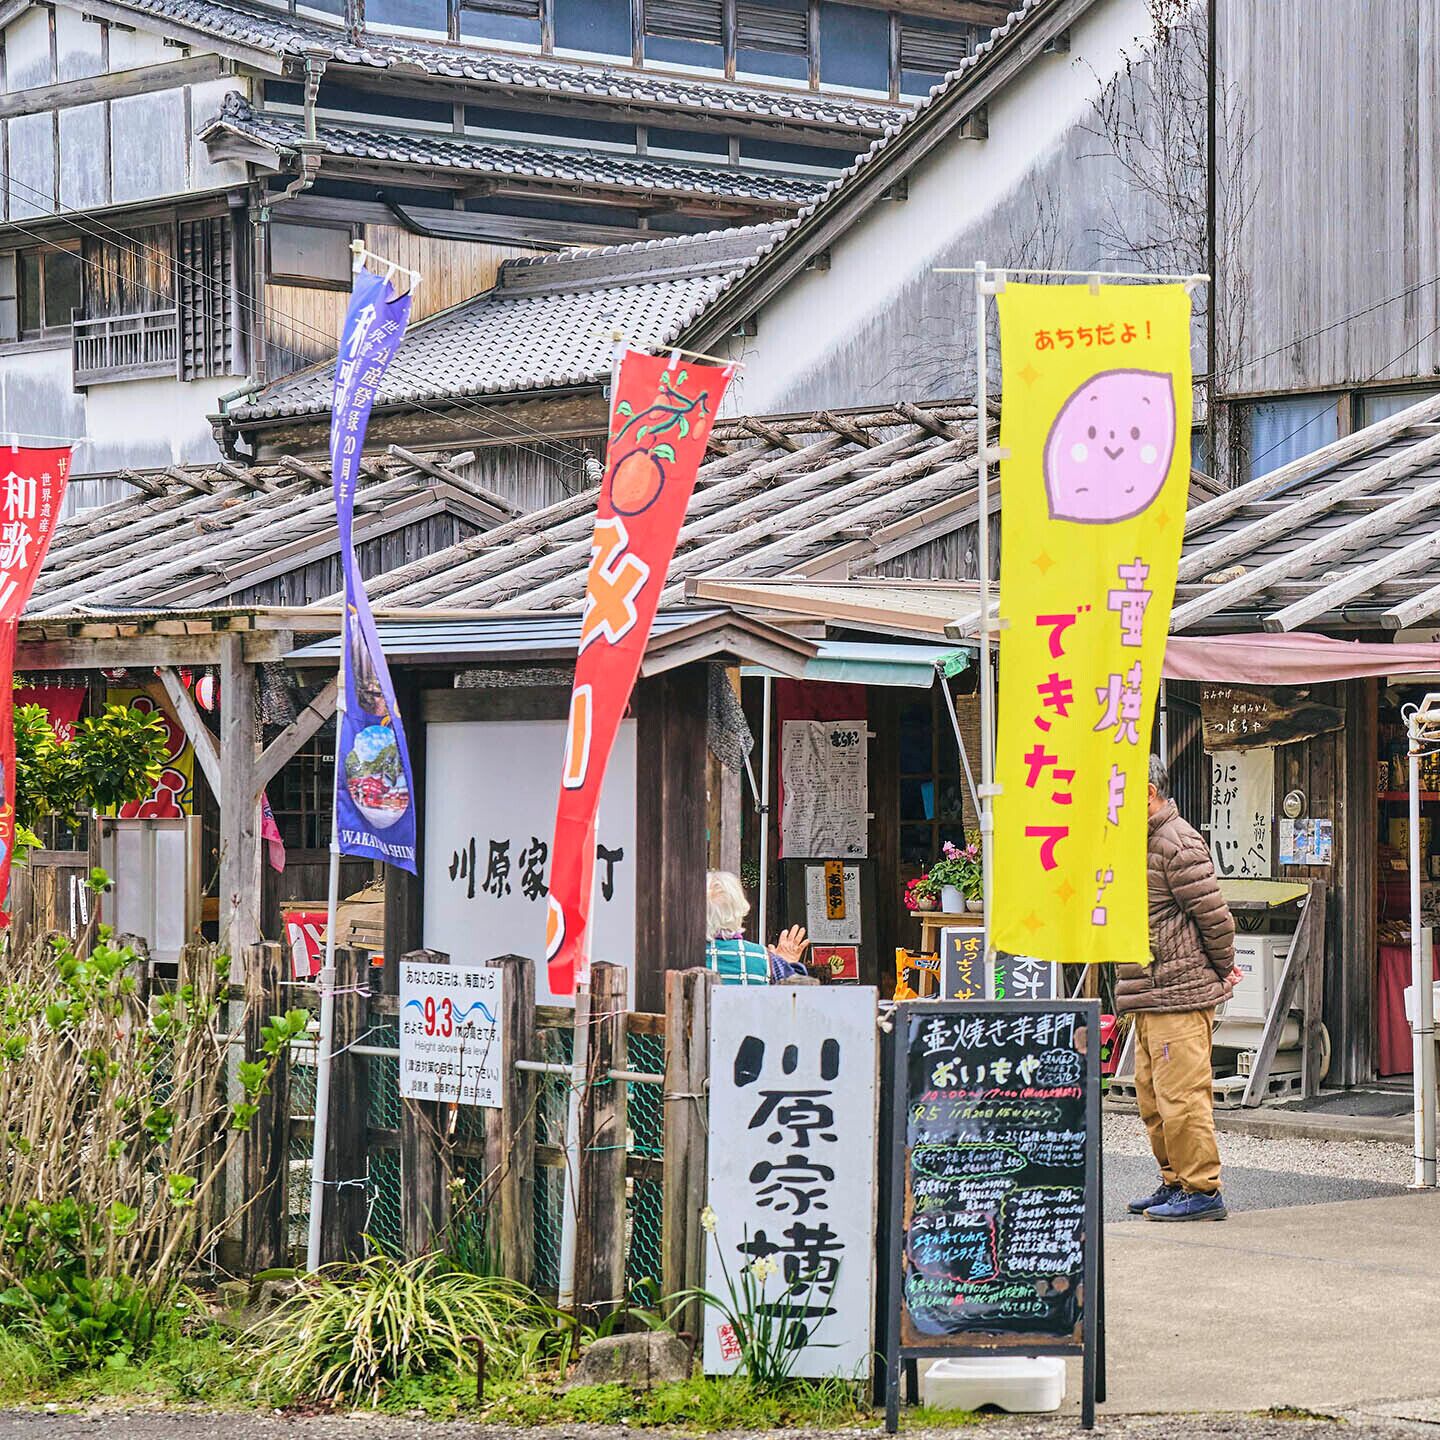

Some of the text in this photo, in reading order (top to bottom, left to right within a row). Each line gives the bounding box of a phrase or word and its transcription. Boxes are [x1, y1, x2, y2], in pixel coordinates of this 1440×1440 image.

[1033, 320, 1153, 353] あちちだよ！
[1023, 603, 1092, 873] できたて
[1212, 763, 1223, 829] うま！
[1223, 765, 1238, 830] にが！
[449, 837, 625, 903] 川原家丁
[406, 969, 497, 990] あなたの足元は、海面から
[424, 996, 454, 1039] 9.3
[922, 1013, 1076, 1056] 壺焼き芋専門
[415, 1040, 434, 1054] Height
[931, 1054, 1041, 1088] おいもや
[734, 1035, 845, 1350] 川原家横丁
